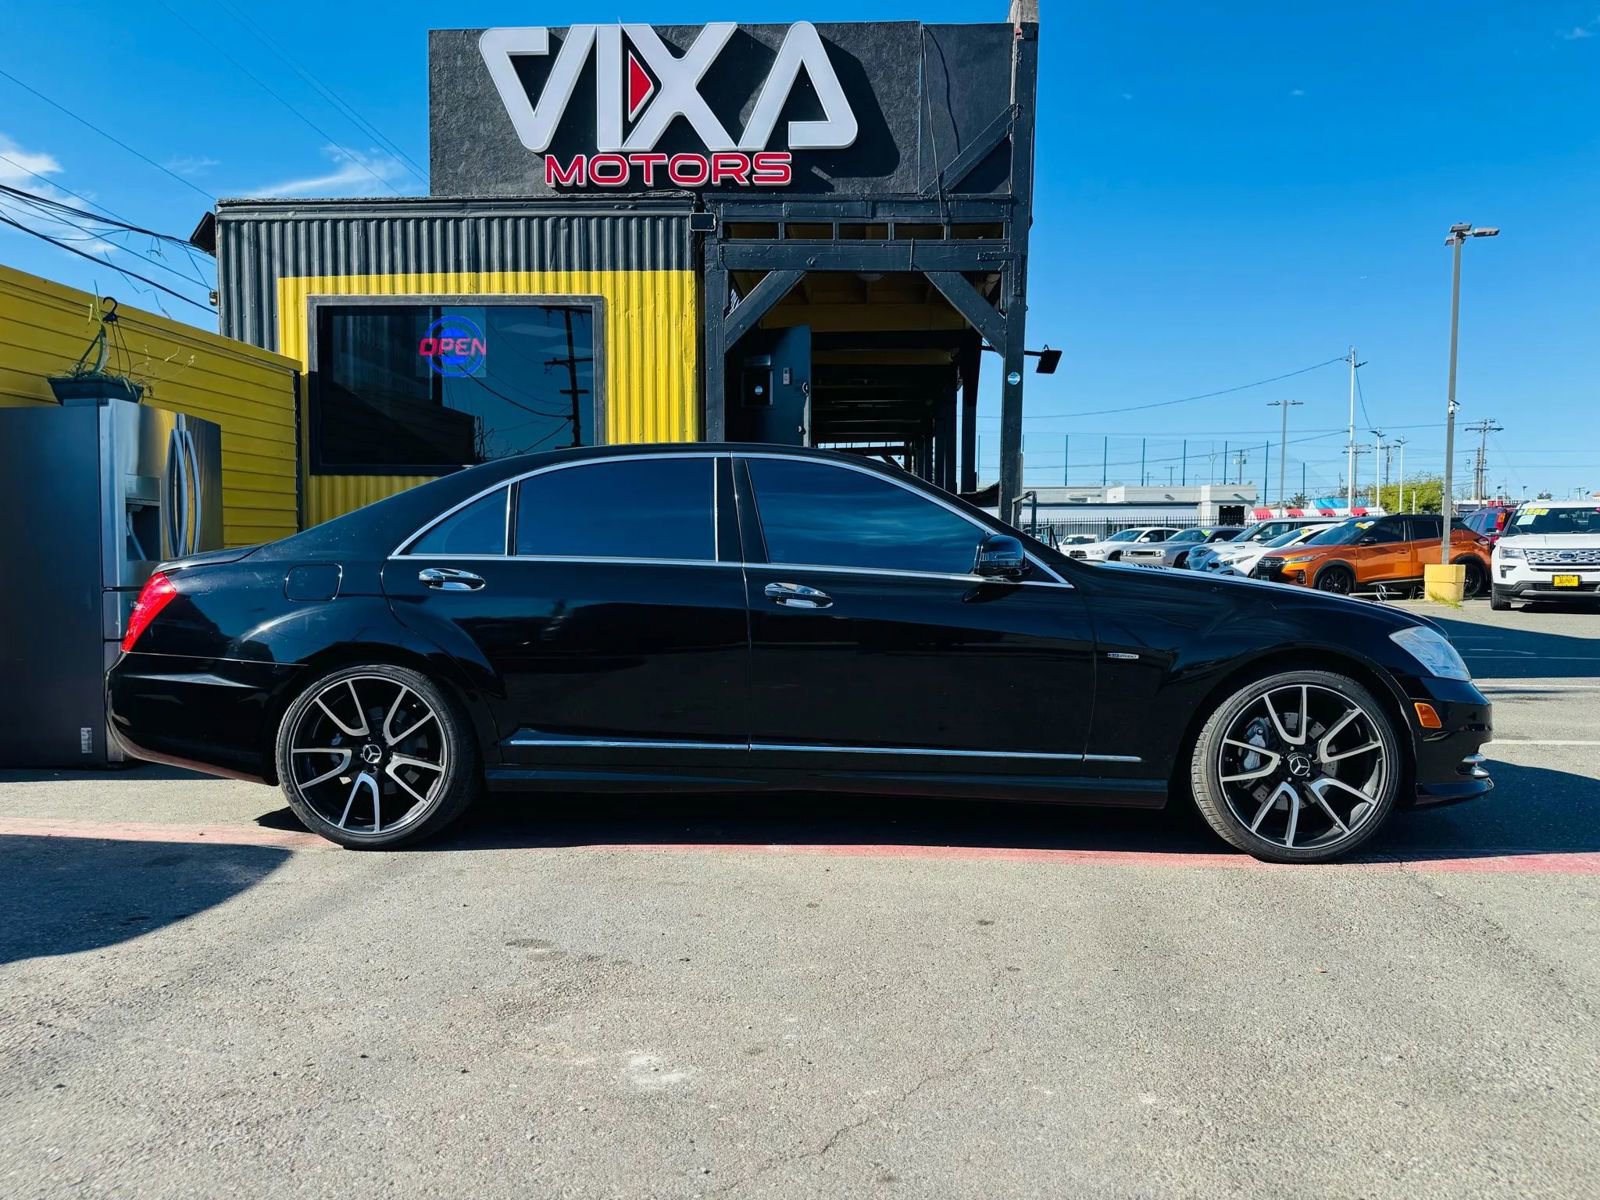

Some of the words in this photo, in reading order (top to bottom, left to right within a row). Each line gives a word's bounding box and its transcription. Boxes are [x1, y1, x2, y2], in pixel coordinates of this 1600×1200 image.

[478, 21, 858, 152] VIXA
[544, 152, 792, 188] MOTORS
[419, 337, 487, 356] OPEN
